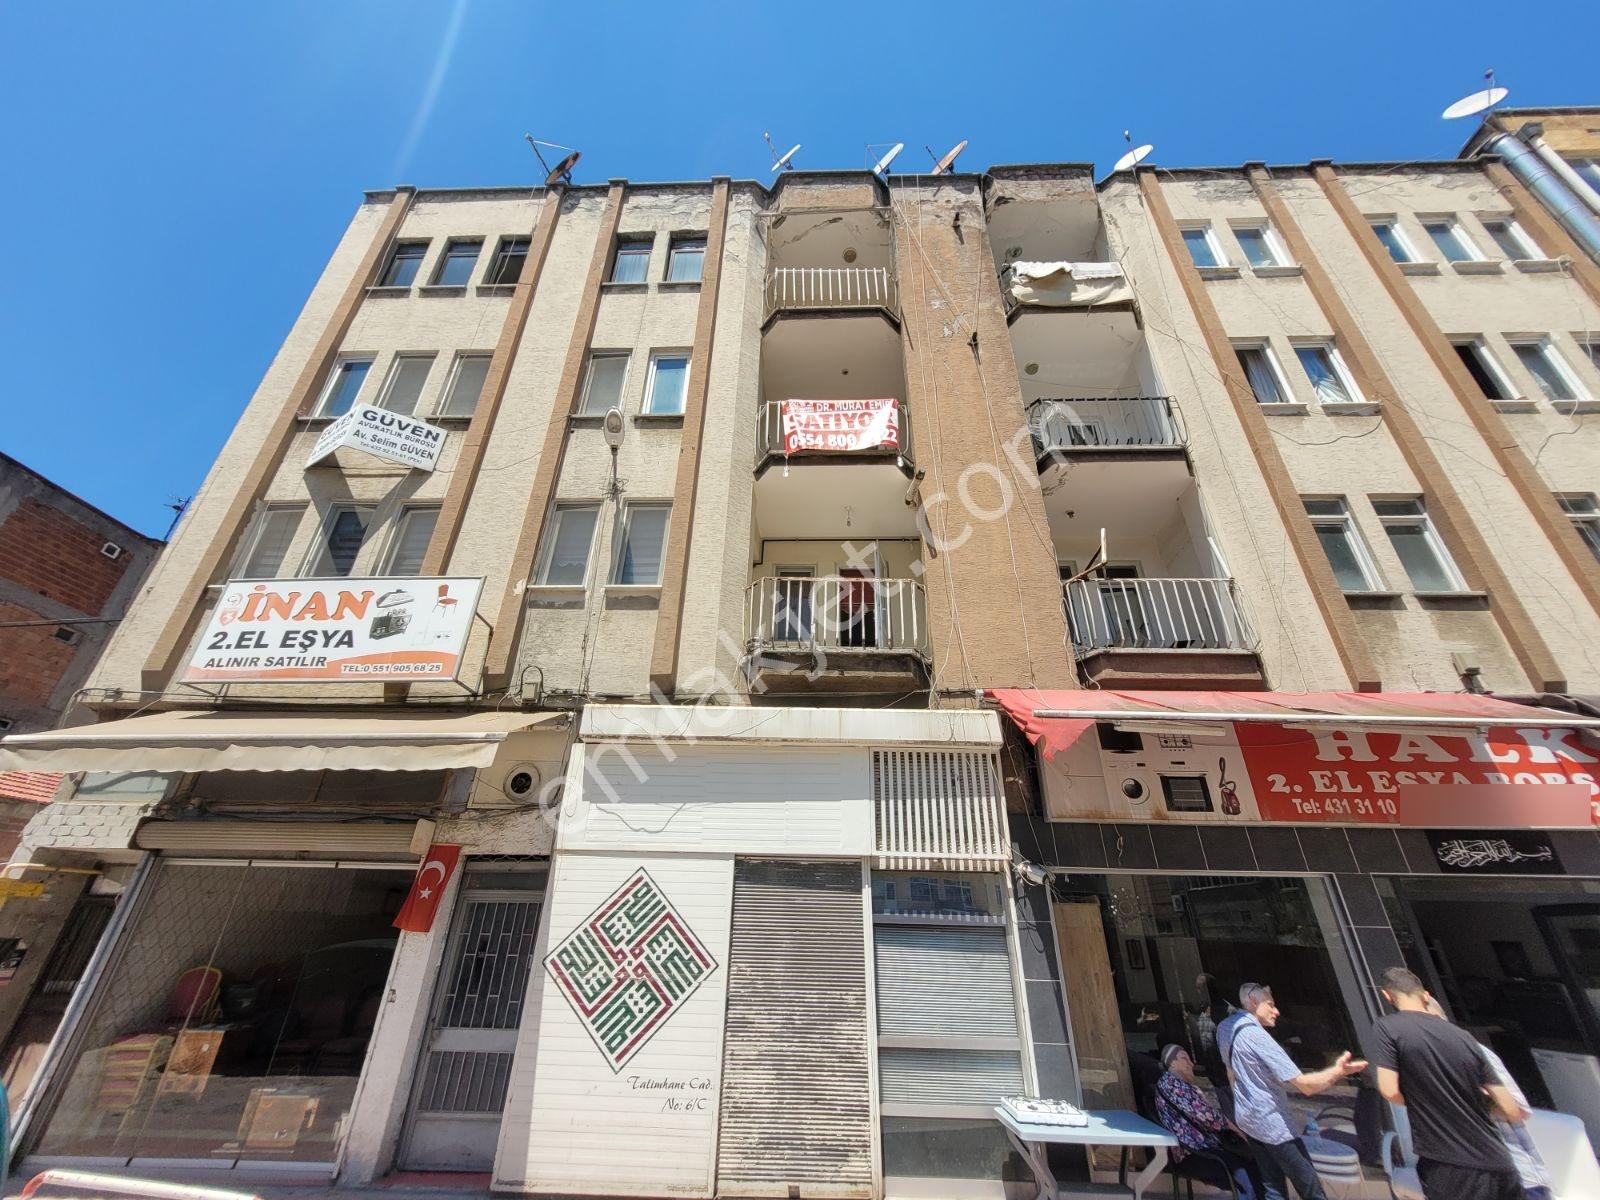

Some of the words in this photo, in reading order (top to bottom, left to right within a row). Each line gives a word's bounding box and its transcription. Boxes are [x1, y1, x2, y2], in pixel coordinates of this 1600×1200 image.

[835, 401, 866, 411] MURAT
[362, 409, 440, 442] GÜVEN
[789, 411, 895, 429] SATIYO
[353, 429, 367, 440] Av.
[370, 433, 398, 449] Selim
[358, 420, 402, 439] AVUKATLIK
[404, 434, 436, 449] BÜROSU
[238, 585, 375, 621] İNAN
[279, 630, 355, 653] EŞYA
[204, 656, 261, 668] ALINIR
[264, 656, 327, 668] SATILIR
[393, 664, 411, 672] 905
[414, 664, 425, 672] 68
[428, 664, 441, 672] 25
[1306, 729, 1600, 763] HALK
[1266, 773, 1302, 793] 2.
[1308, 771, 1362, 793] EL
[1292, 799, 1322, 814] Tel:
[1325, 799, 1352, 815] 431
[1354, 799, 1374, 815] 31
[1377, 799, 1397, 815] 10
[689, 1077, 713, 1090] Cad.
[661, 1098, 682, 1112] No:
[685, 1098, 708, 1112] 6/C
